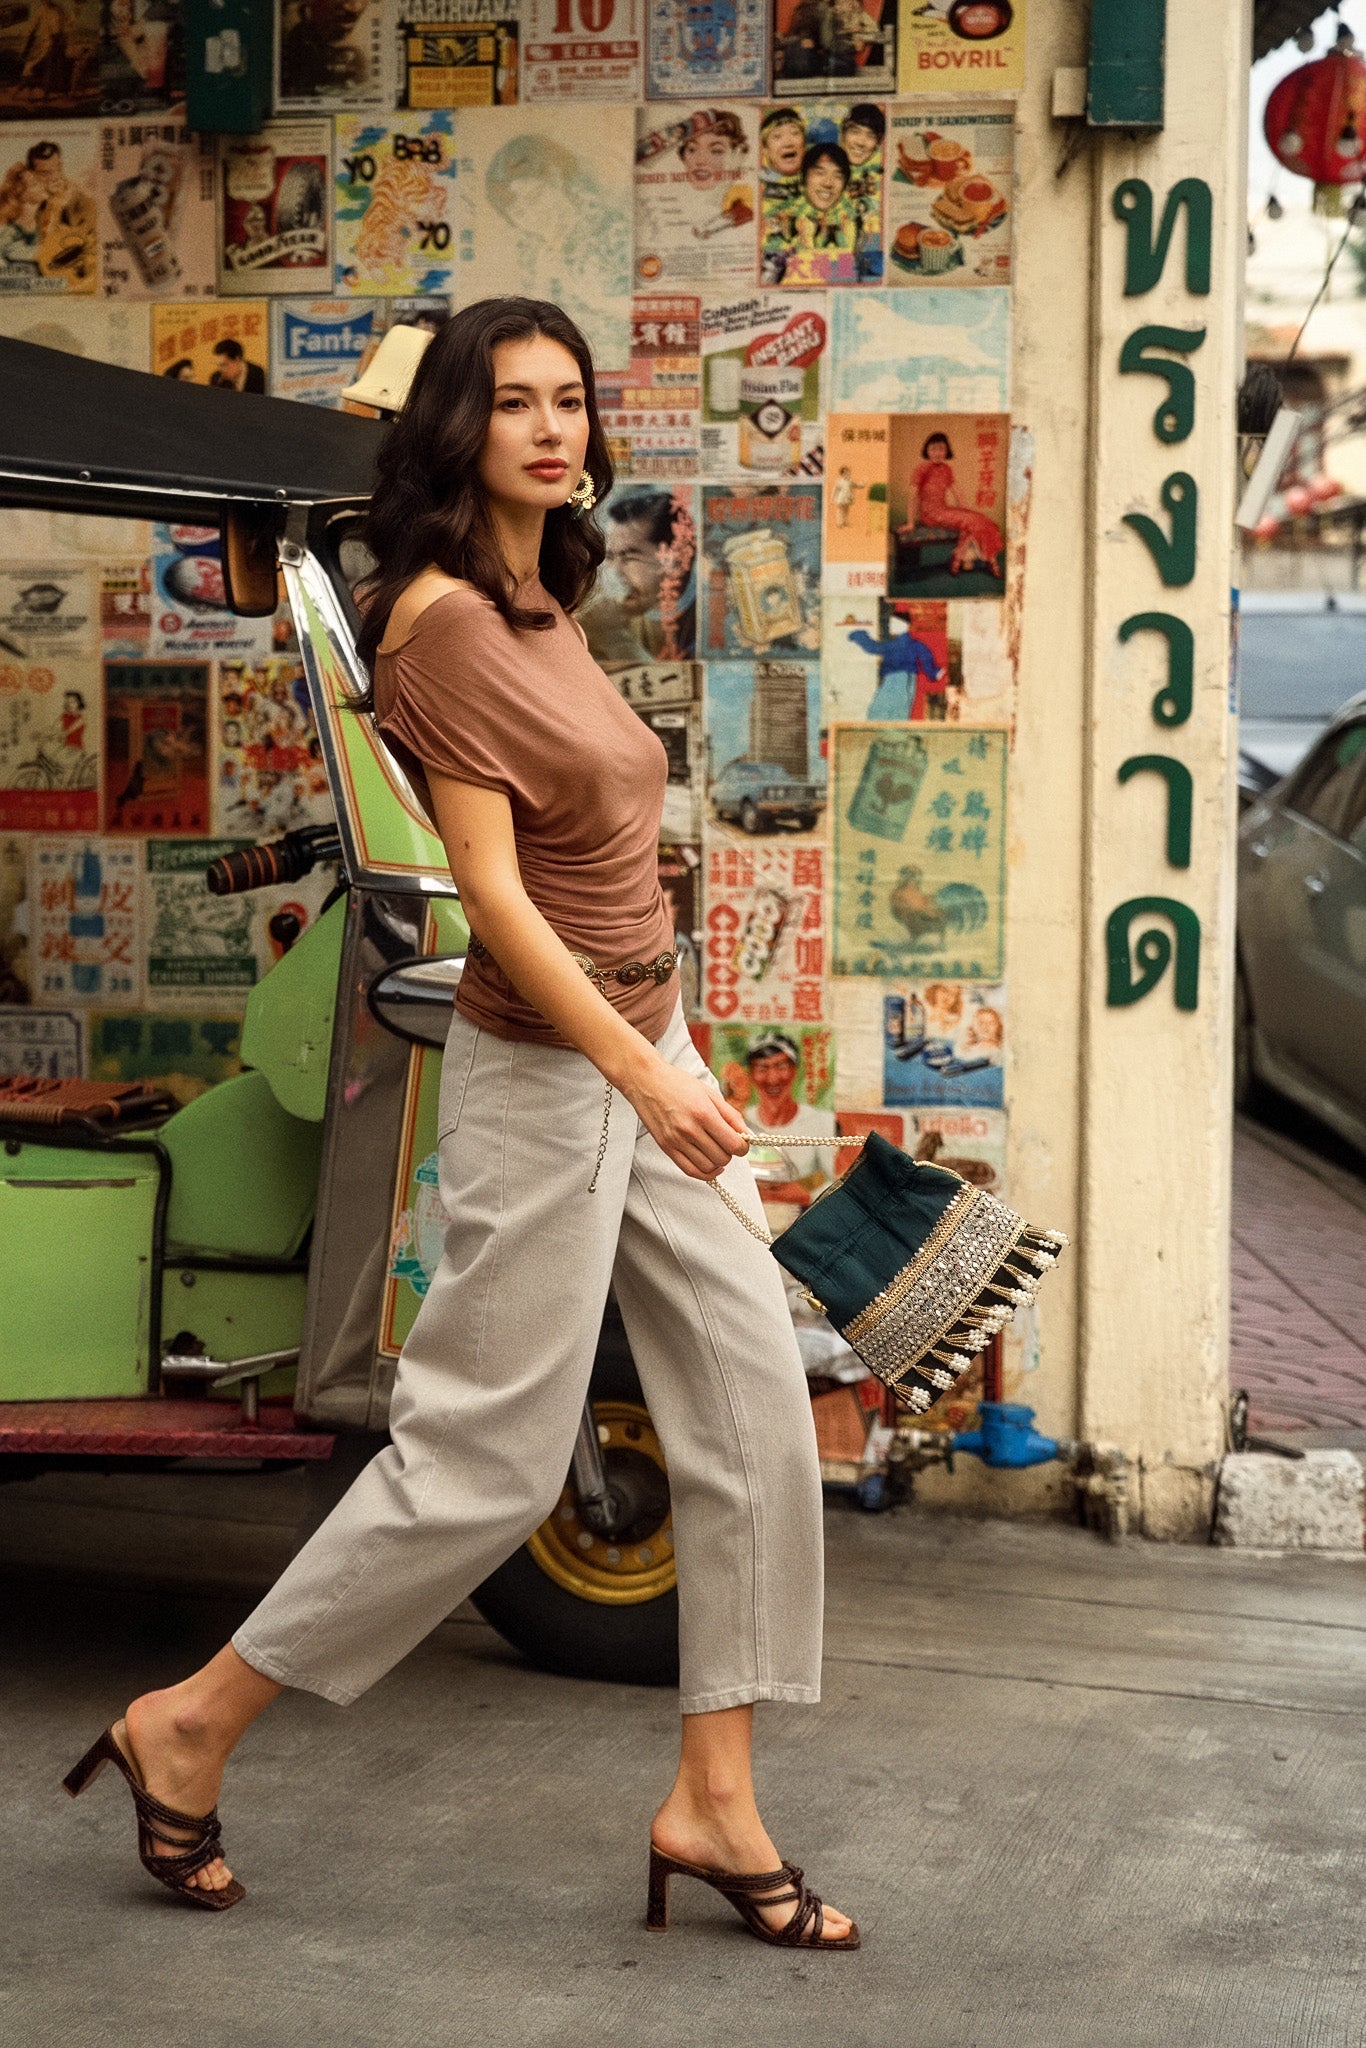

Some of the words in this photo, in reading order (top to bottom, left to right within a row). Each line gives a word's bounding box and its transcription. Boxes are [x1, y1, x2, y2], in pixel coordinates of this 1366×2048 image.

[918, 50, 1007, 70] BOVRIL
[342, 155, 378, 185] YO
[289, 324, 368, 358] Fanta
[750, 318, 814, 367] INSTANT
[1106, 177, 1213, 1012] ทรงวาด
